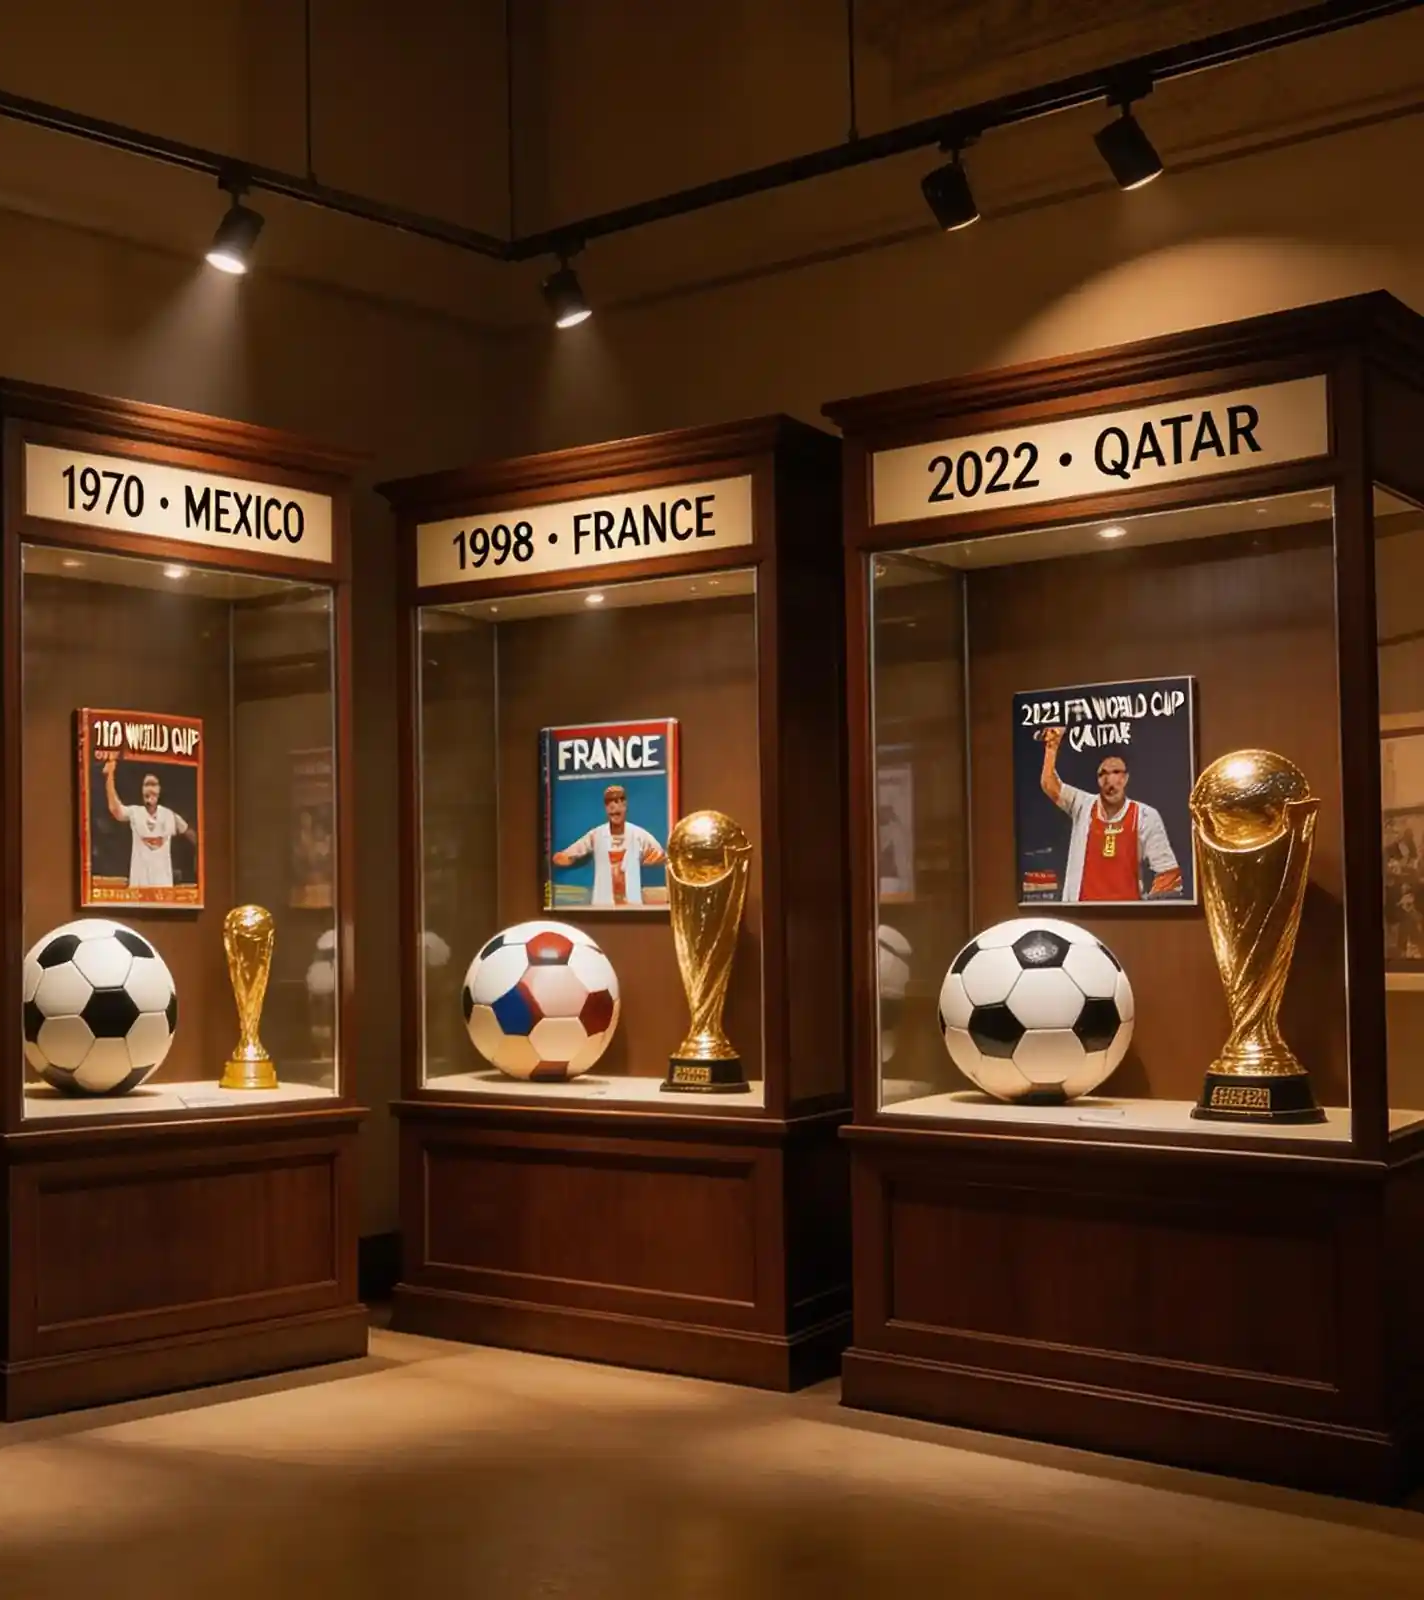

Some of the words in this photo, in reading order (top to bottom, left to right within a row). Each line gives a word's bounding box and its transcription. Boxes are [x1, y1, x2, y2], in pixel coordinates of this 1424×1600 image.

[927, 441, 1040, 503] 2022
[1094, 404, 1263, 480] QATAR
[62, 464, 145, 518] 1970
[184, 485, 305, 544] MEXICO
[452, 521, 534, 570] 1998
[573, 494, 716, 555] FRANCE
[557, 735, 662, 772] FRANCE
